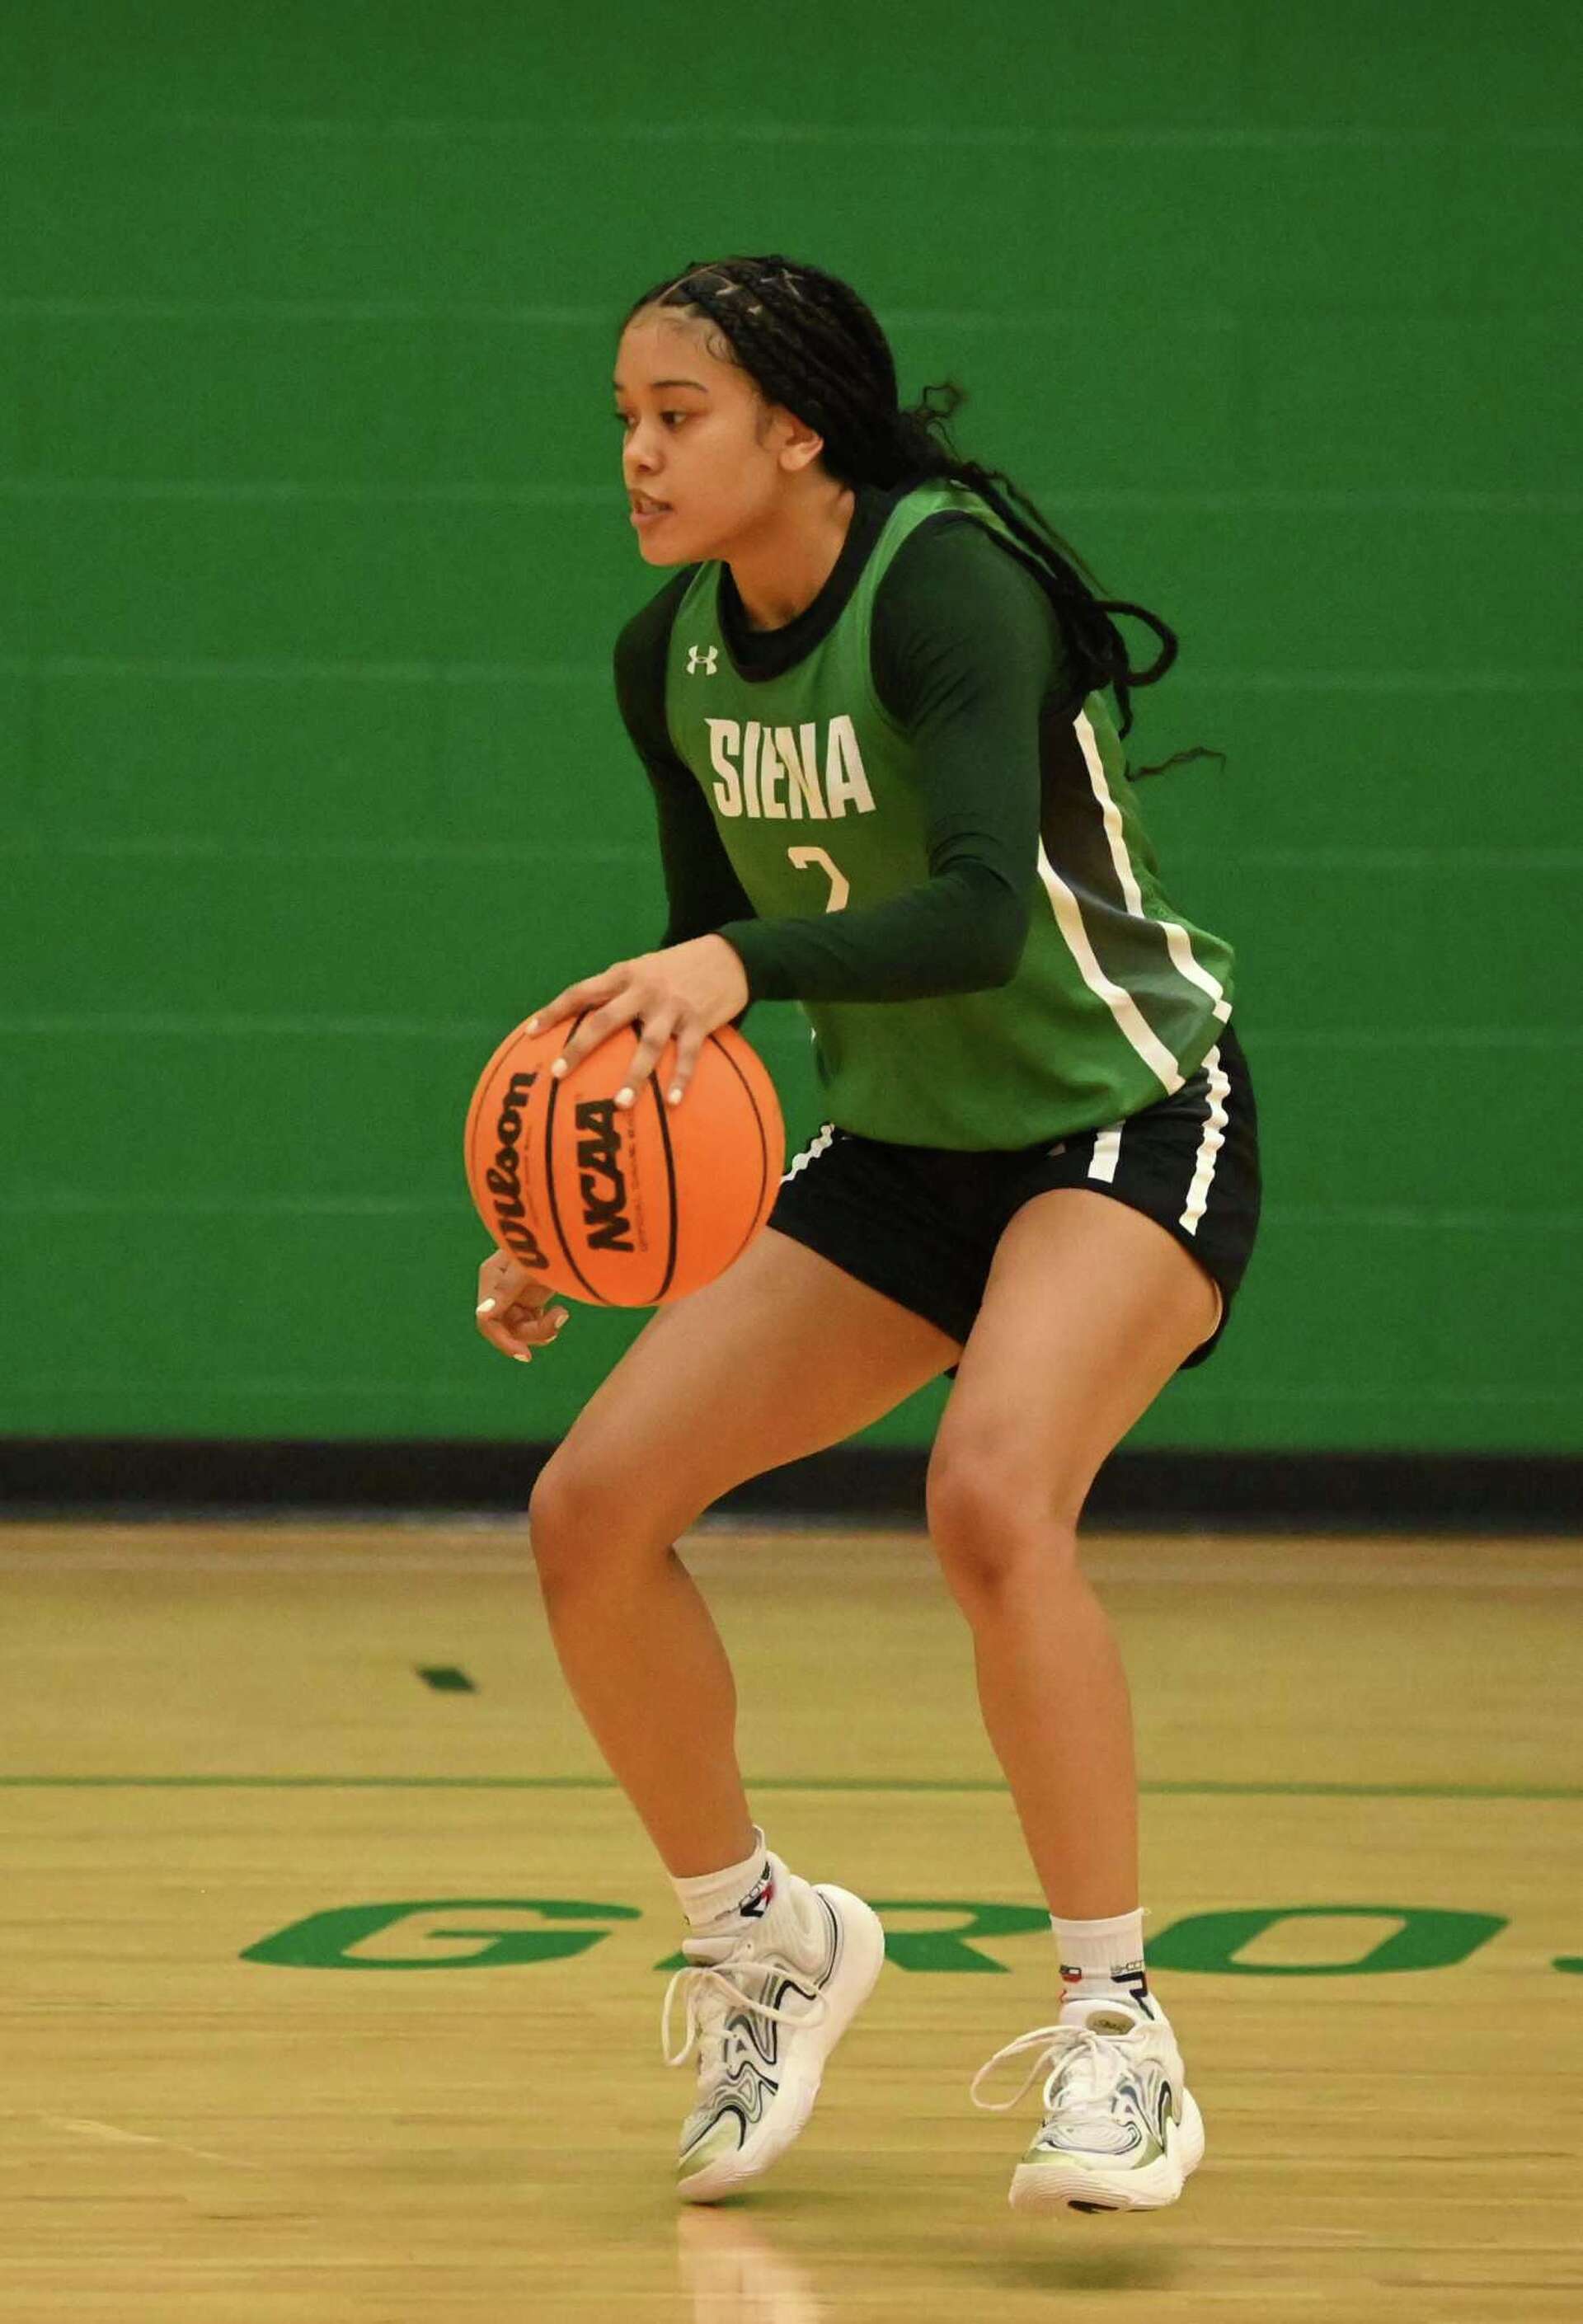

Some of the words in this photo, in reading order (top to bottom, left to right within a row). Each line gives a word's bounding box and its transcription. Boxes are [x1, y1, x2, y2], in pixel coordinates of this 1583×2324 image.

[704, 715, 876, 819] SIENA
[486, 1072, 550, 1270] Wilson
[575, 1097, 634, 1253] NCAA
